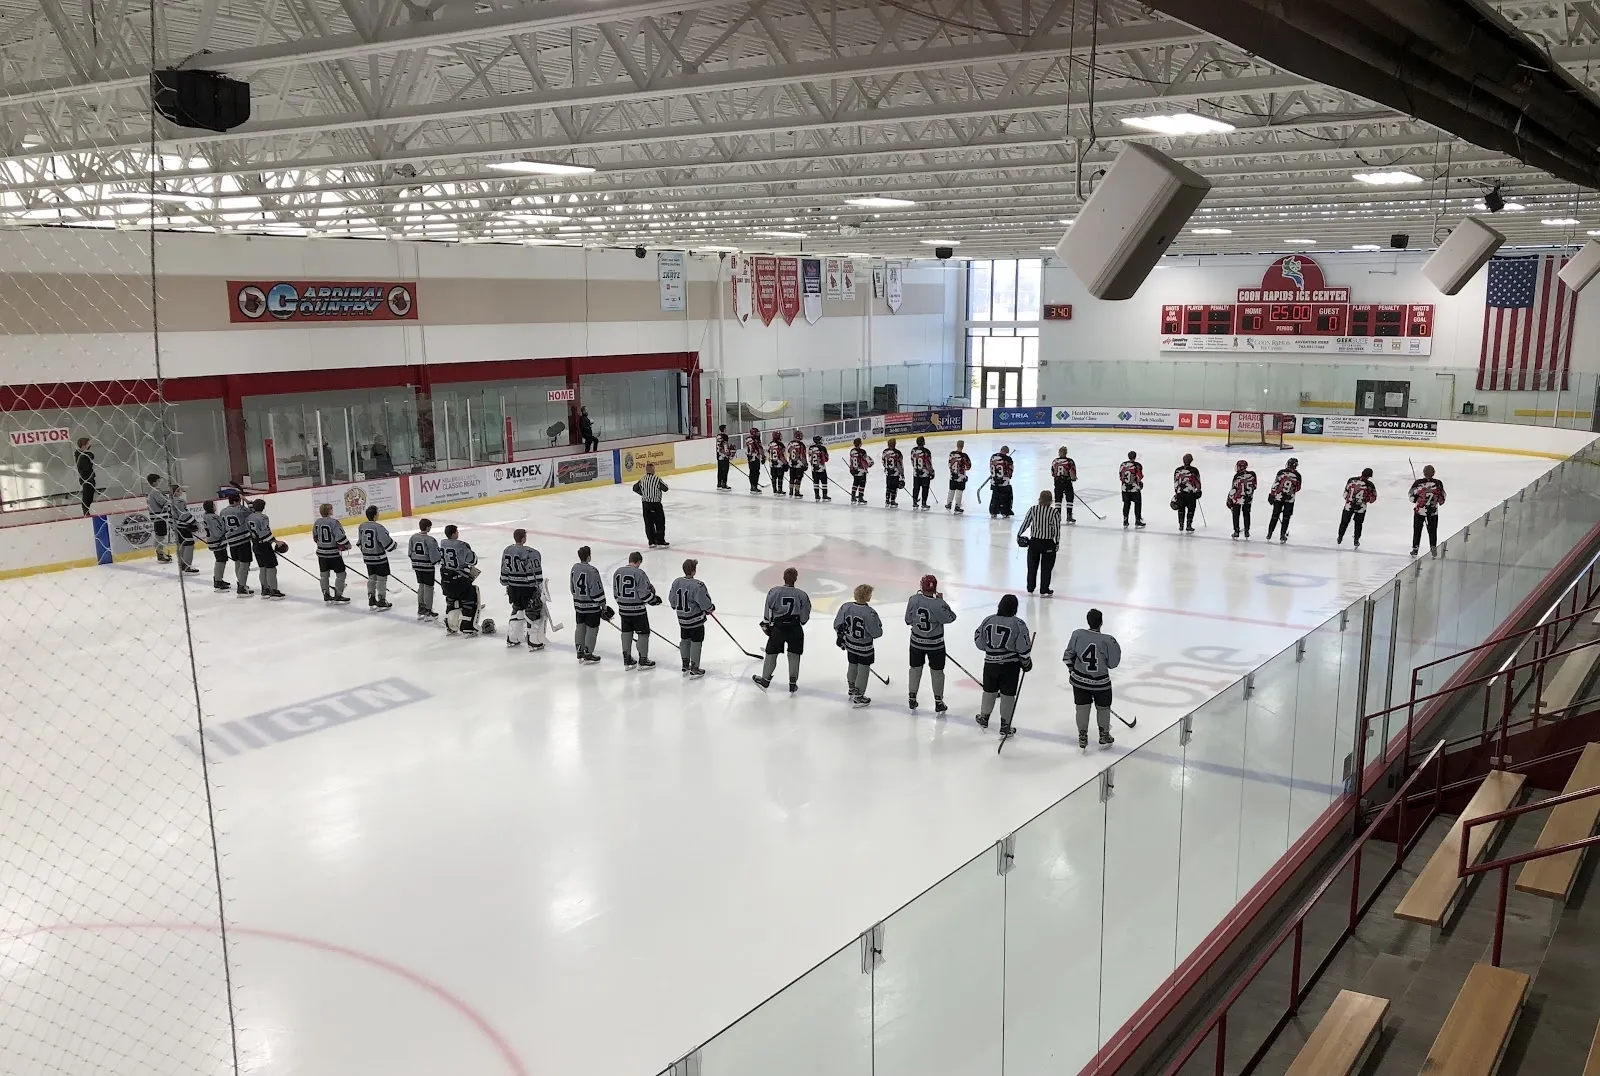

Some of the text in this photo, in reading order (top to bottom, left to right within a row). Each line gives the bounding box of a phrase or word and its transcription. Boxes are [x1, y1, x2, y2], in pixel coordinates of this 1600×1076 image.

[1239, 290, 1347, 302] COON RAPIDS ICE CENTER
[1253, 316, 1262, 330] 0
[1328, 316, 1338, 331] 0
[548, 390, 574, 400] HOME
[11, 429, 69, 445] VISITOR
[635, 450, 664, 460] Coon Rapids
[769, 449, 778, 460] 12
[884, 457, 895, 468] 13
[913, 457, 924, 469] 19
[951, 461, 958, 474] 4
[506, 464, 542, 479] MrPEX
[1124, 471, 1132, 483] 3
[443, 479, 481, 491] CLASSIC REALTY
[1240, 481, 1253, 495] 15
[1283, 480, 1292, 493] 9
[1349, 488, 1364, 503] 14
[1425, 492, 1434, 505] 7
[571, 571, 588, 597] 14
[615, 573, 636, 599] 12
[675, 587, 691, 614] 11
[781, 596, 796, 617] 7
[916, 607, 932, 632] 3
[845, 615, 866, 641] 16
[985, 623, 1012, 650] 17
[1081, 642, 1099, 673] 4
[267, 681, 413, 732] CTN
